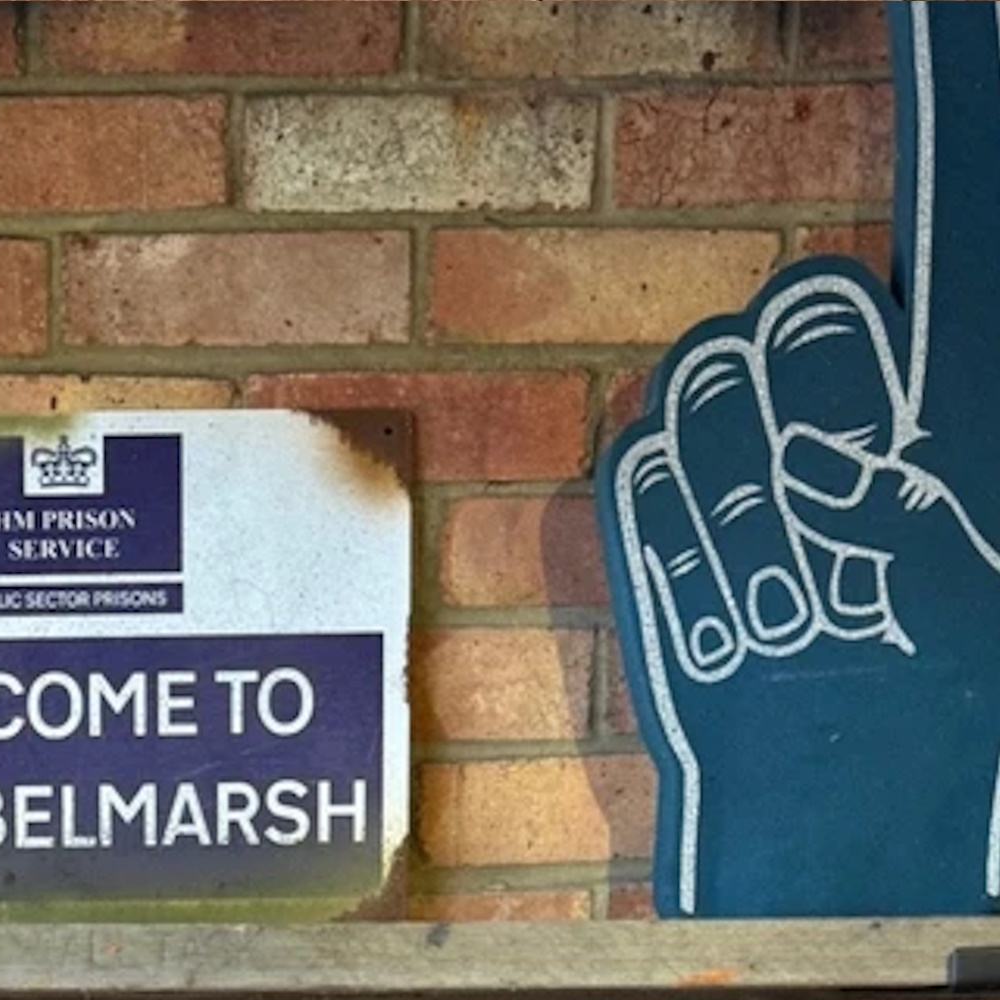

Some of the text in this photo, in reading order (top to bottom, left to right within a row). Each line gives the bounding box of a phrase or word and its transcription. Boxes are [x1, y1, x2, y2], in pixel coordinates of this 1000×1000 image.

[43, 510, 135, 529] PRISON
[9, 539, 118, 558] SERVICE
[25, 591, 90, 608] SECTOR
[93, 591, 166, 607] PRISONS
[215, 668, 313, 734] TO
